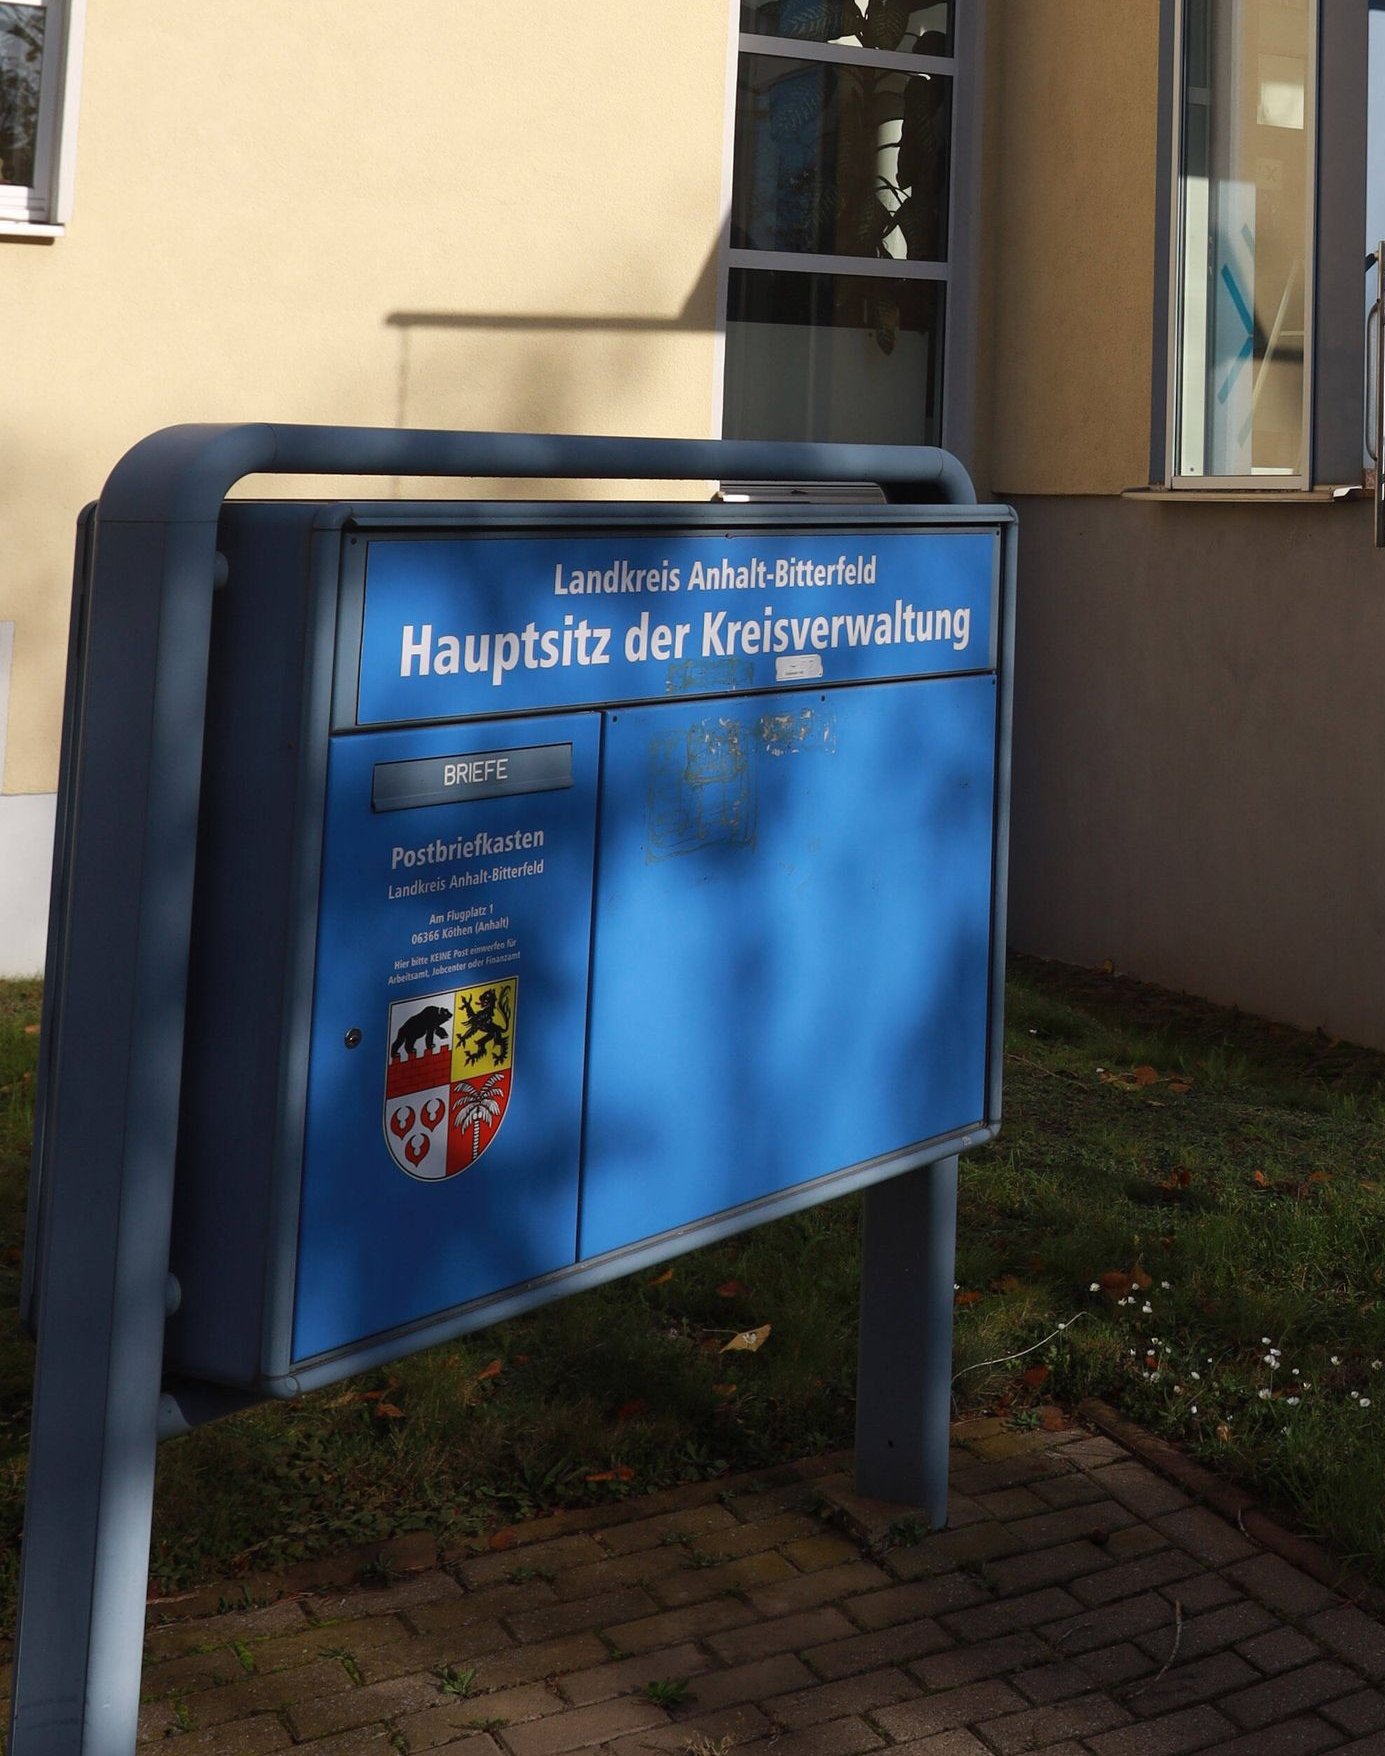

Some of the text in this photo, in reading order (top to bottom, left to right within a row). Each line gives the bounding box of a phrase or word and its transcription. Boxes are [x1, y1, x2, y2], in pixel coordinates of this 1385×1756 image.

[554, 554, 878, 595] Landkreis Anhalt-Bitterfeld
[400, 599, 971, 686] Hauptsitz der Kreisverwaltung
[444, 758, 508, 786] BRIEFE
[392, 830, 544, 870] Postbriefkasten
[389, 860, 544, 900] Landkreis Anhalt-Bitterfeld
[411, 917, 509, 945] 06366 Köthen (Anhalt)
[429, 904, 494, 925] Am Flugplatz 1
[388, 951, 521, 985] Arbeitsamt, Jobcenter oder Finanzamt
[394, 959, 409, 970] Hier
[411, 955, 429, 967] bitte
[430, 950, 452, 964] KEINE
[453, 946, 469, 960] Post
